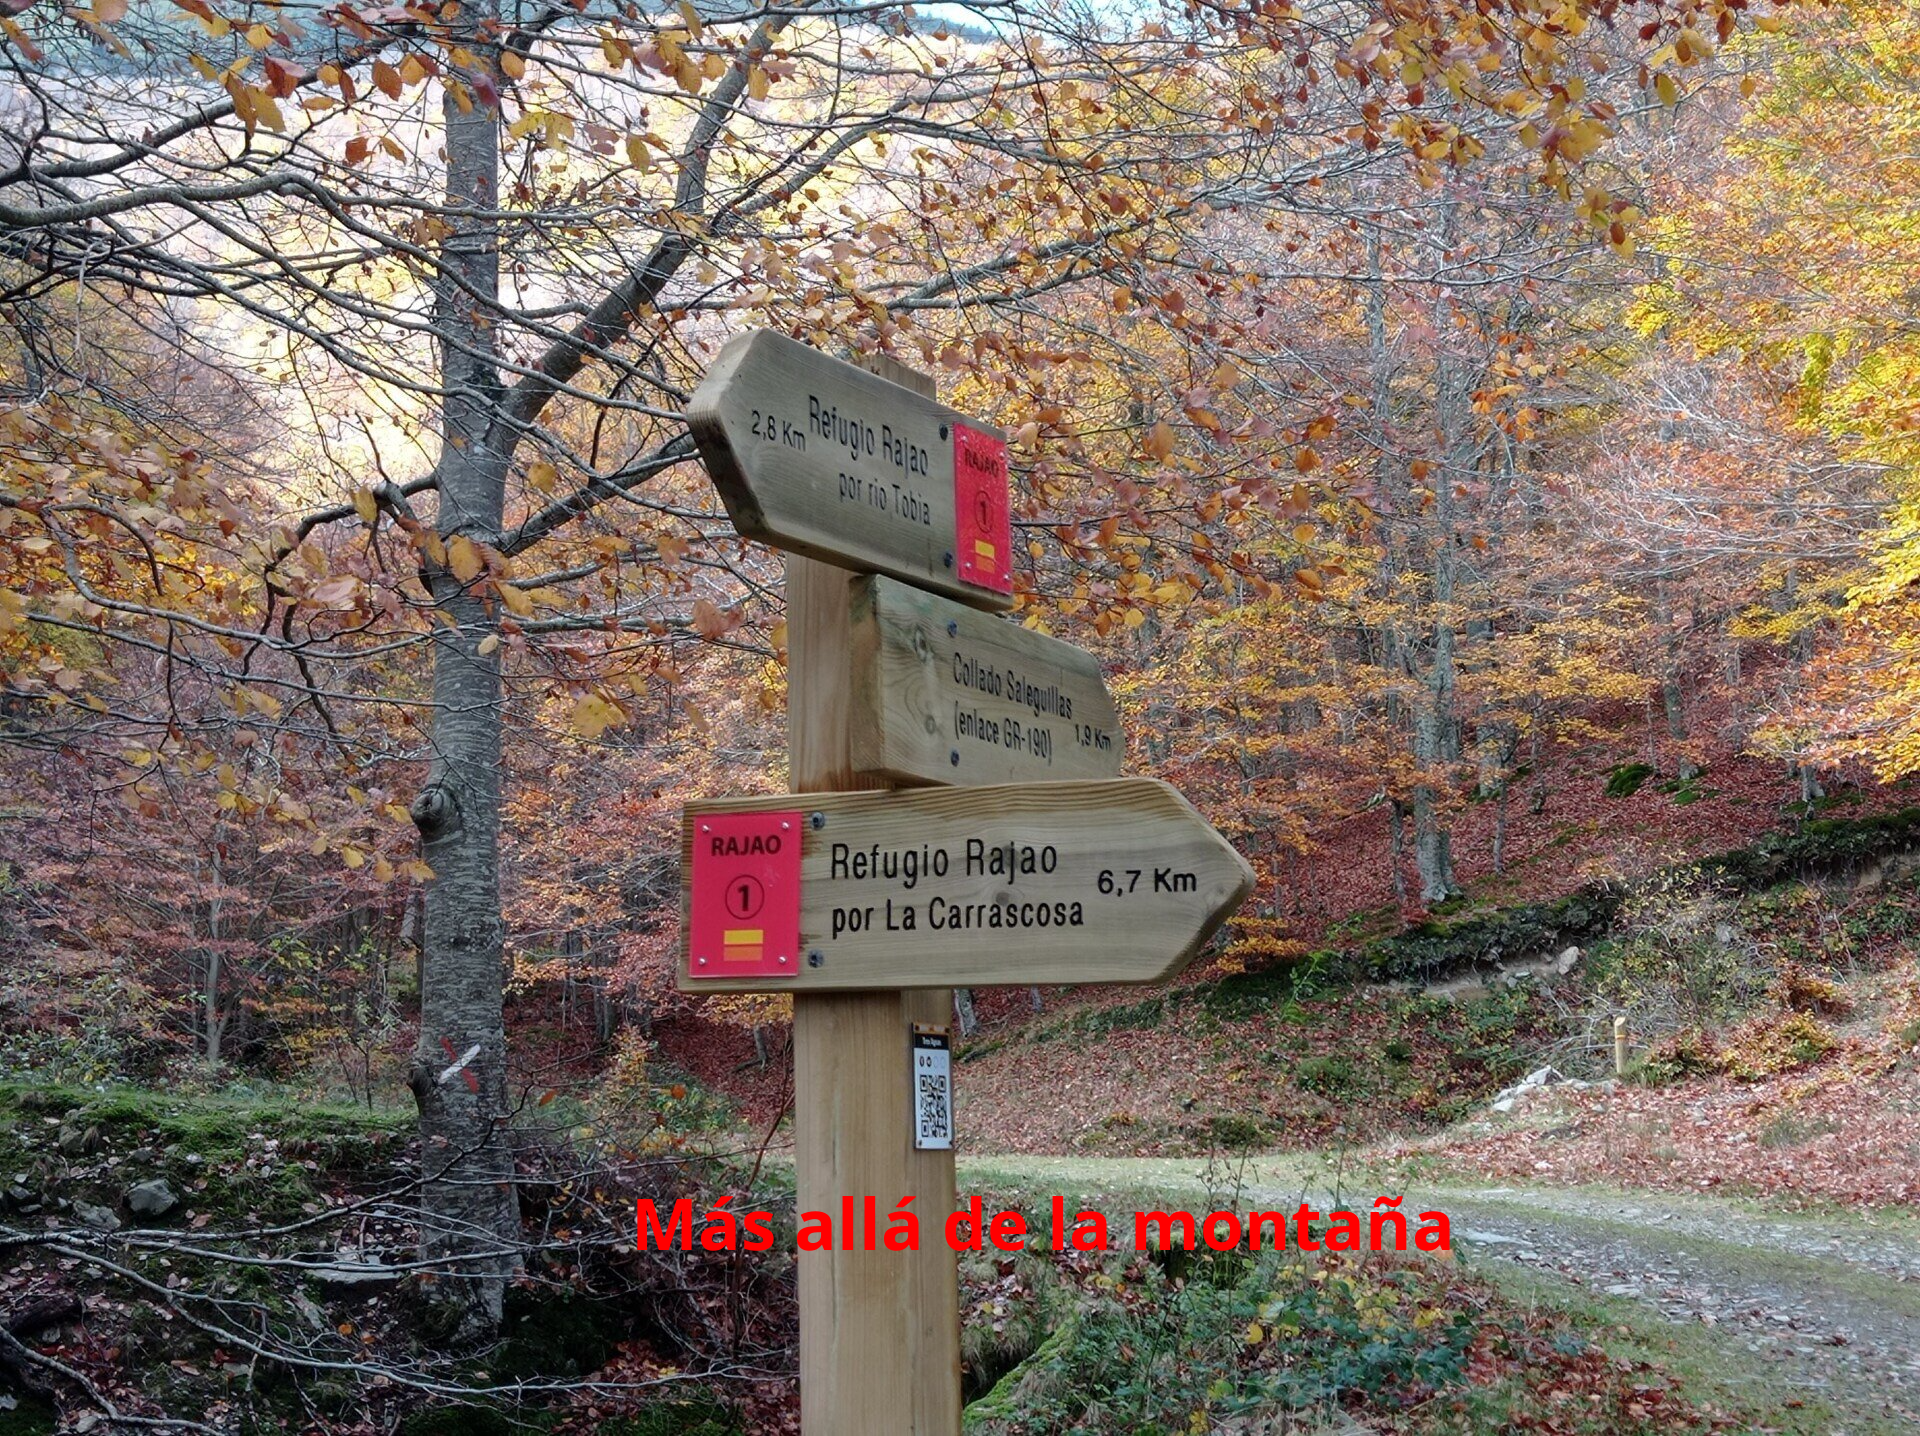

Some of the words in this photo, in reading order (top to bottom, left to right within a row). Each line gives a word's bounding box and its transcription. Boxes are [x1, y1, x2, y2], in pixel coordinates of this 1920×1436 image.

[751, 409, 776, 441] 2,8
[783, 420, 806, 452] Km
[809, 395, 875, 462] Refugio
[882, 424, 929, 479] Rajao
[965, 448, 999, 478] RAJAO
[839, 472, 862, 503] por
[953, 652, 1001, 697] Collado
[1006, 670, 1073, 720] Saleguillas
[955, 699, 999, 741] (enlace
[1003, 718, 1053, 768] GR-190)
[1075, 724, 1092, 747] 1,9
[1094, 727, 1112, 751] Km
[711, 835, 782, 857] RAJAO
[831, 843, 949, 889] Refugio
[966, 838, 1058, 885] Rajao
[737, 884, 750, 912] 1
[1097, 869, 1142, 897] 6,7
[1154, 867, 1198, 893] Km
[832, 906, 874, 940] por
[886, 898, 916, 931] La
[928, 896, 1084, 931] Carrascosa
